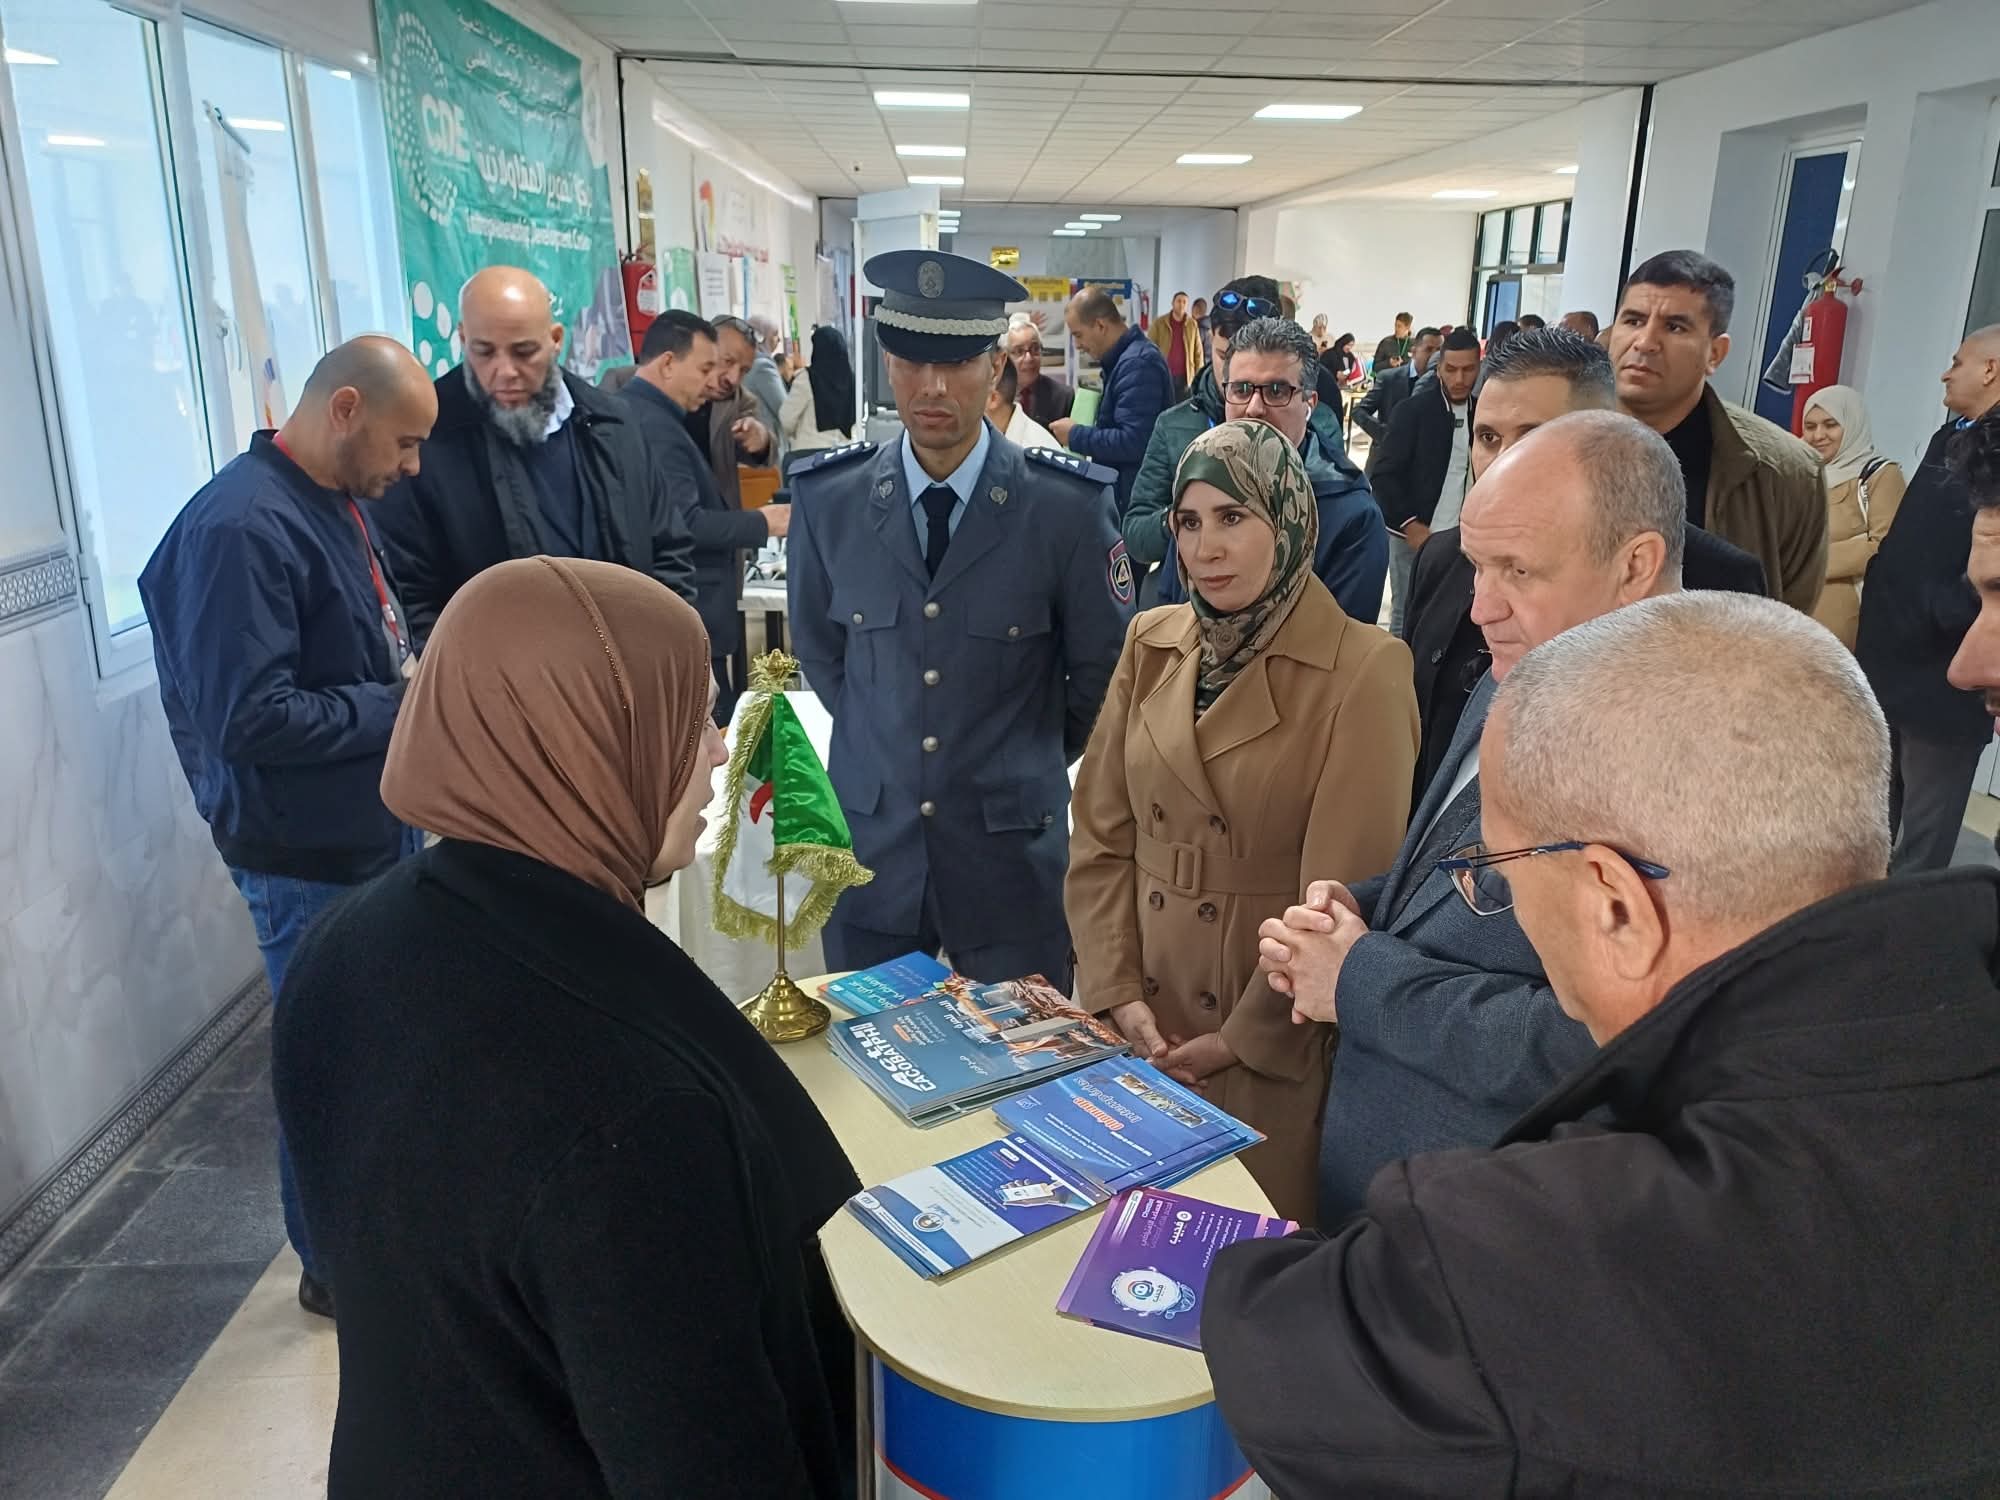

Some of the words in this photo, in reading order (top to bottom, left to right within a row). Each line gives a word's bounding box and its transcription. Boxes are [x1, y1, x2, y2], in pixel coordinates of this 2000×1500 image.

[421, 94, 470, 163] CDE
[852, 1029, 923, 1092] Actu
[866, 1026, 937, 1092] CACOBATPH
